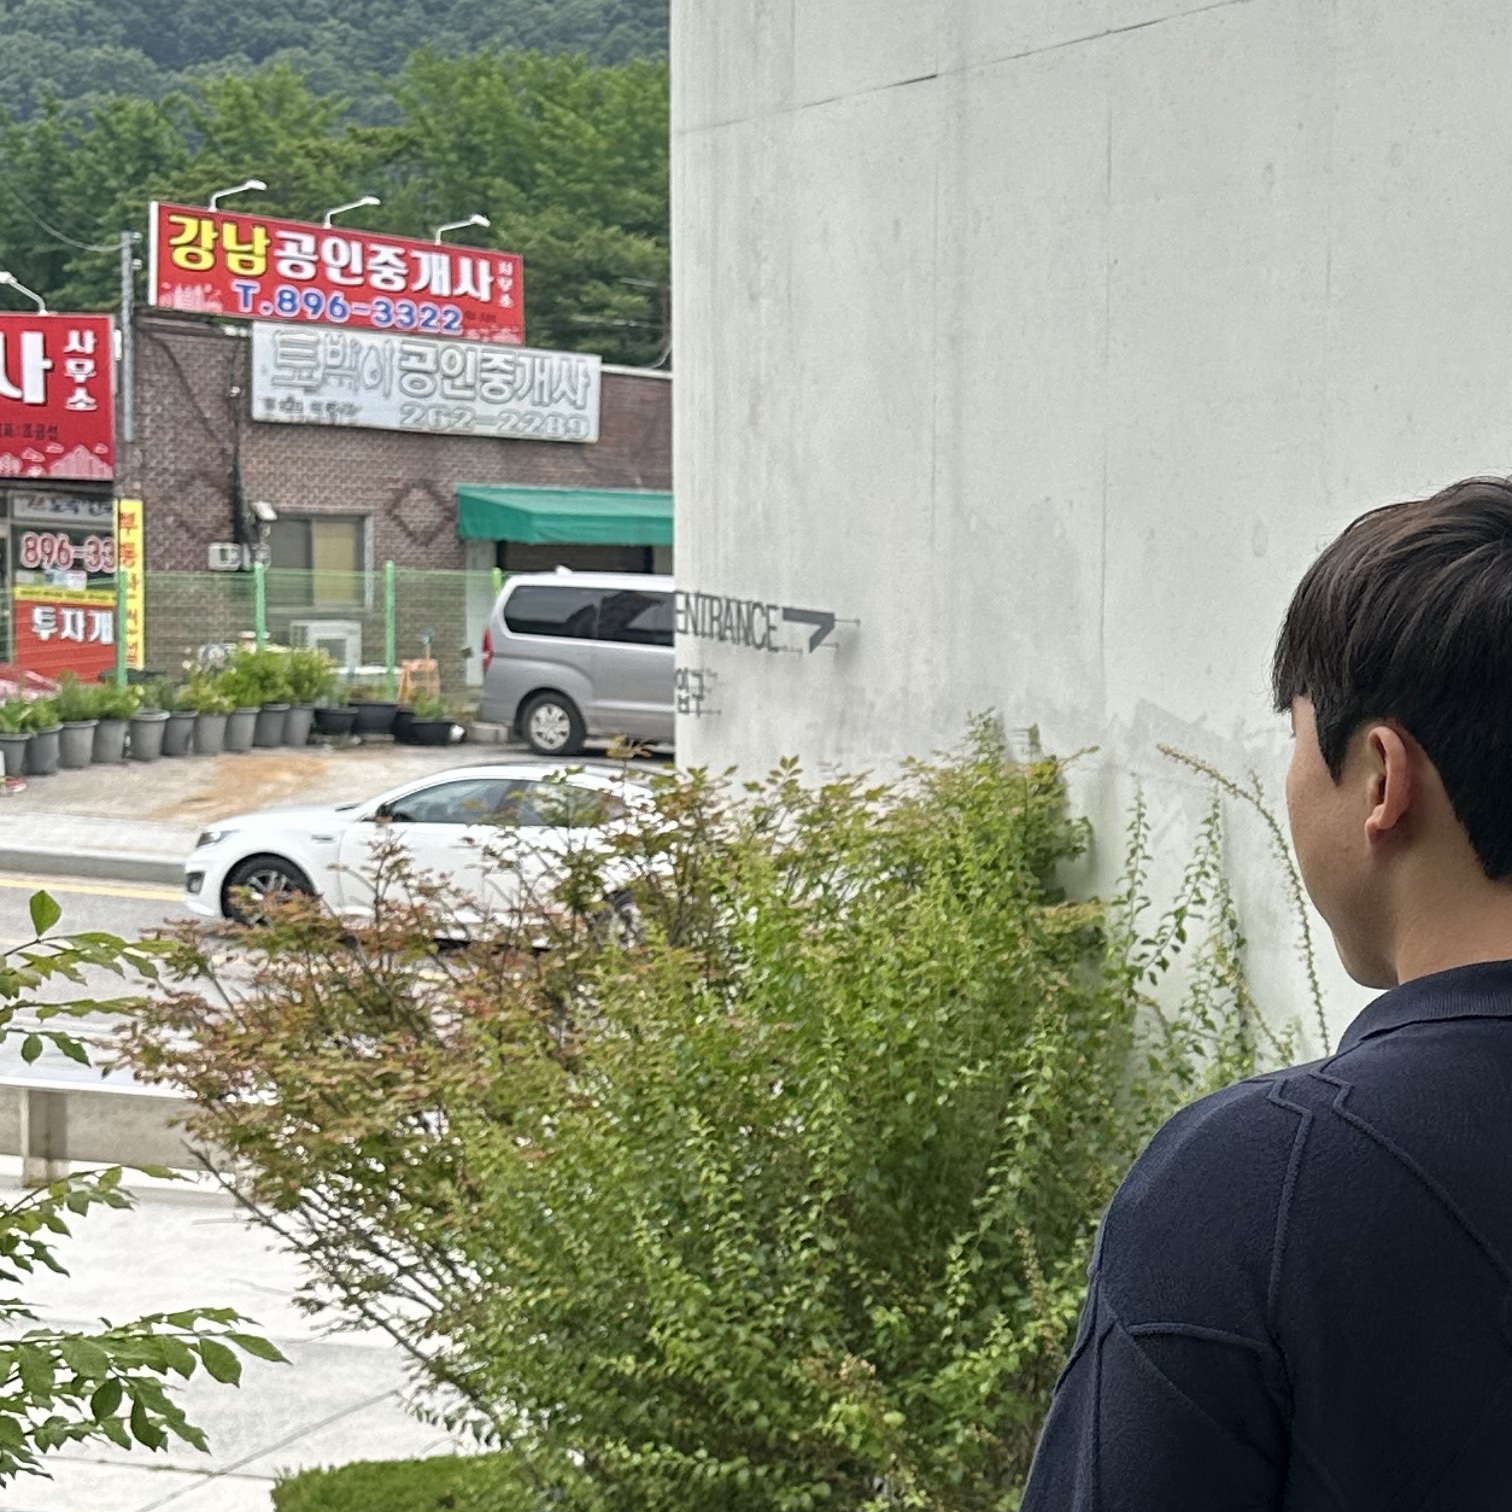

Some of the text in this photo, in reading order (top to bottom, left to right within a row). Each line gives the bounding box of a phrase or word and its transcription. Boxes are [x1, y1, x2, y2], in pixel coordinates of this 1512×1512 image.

[231, 279, 463, 335] T.896-3322
[63, 329, 98, 411] 사무소
[675, 590, 780, 653] ENTRANCE
